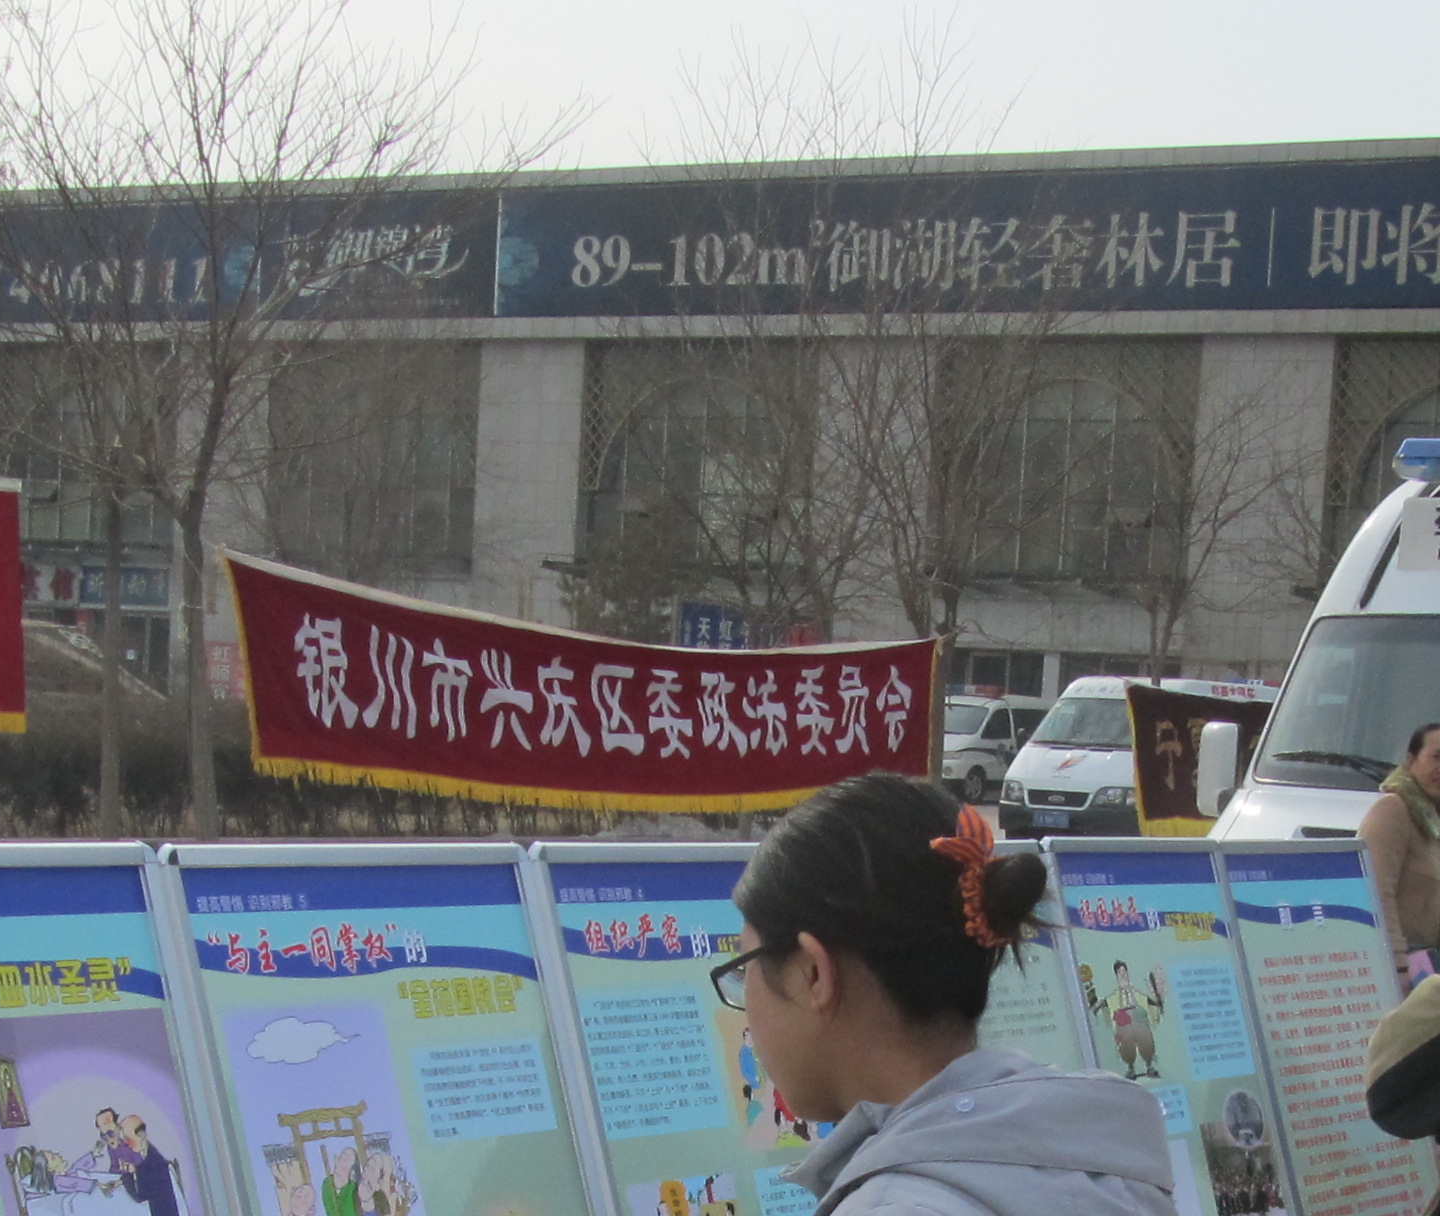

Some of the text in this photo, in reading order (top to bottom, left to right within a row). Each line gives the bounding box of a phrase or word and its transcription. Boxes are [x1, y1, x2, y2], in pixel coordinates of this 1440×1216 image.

[293, 611, 913, 759] 银川市兴庆区委政法委员会
